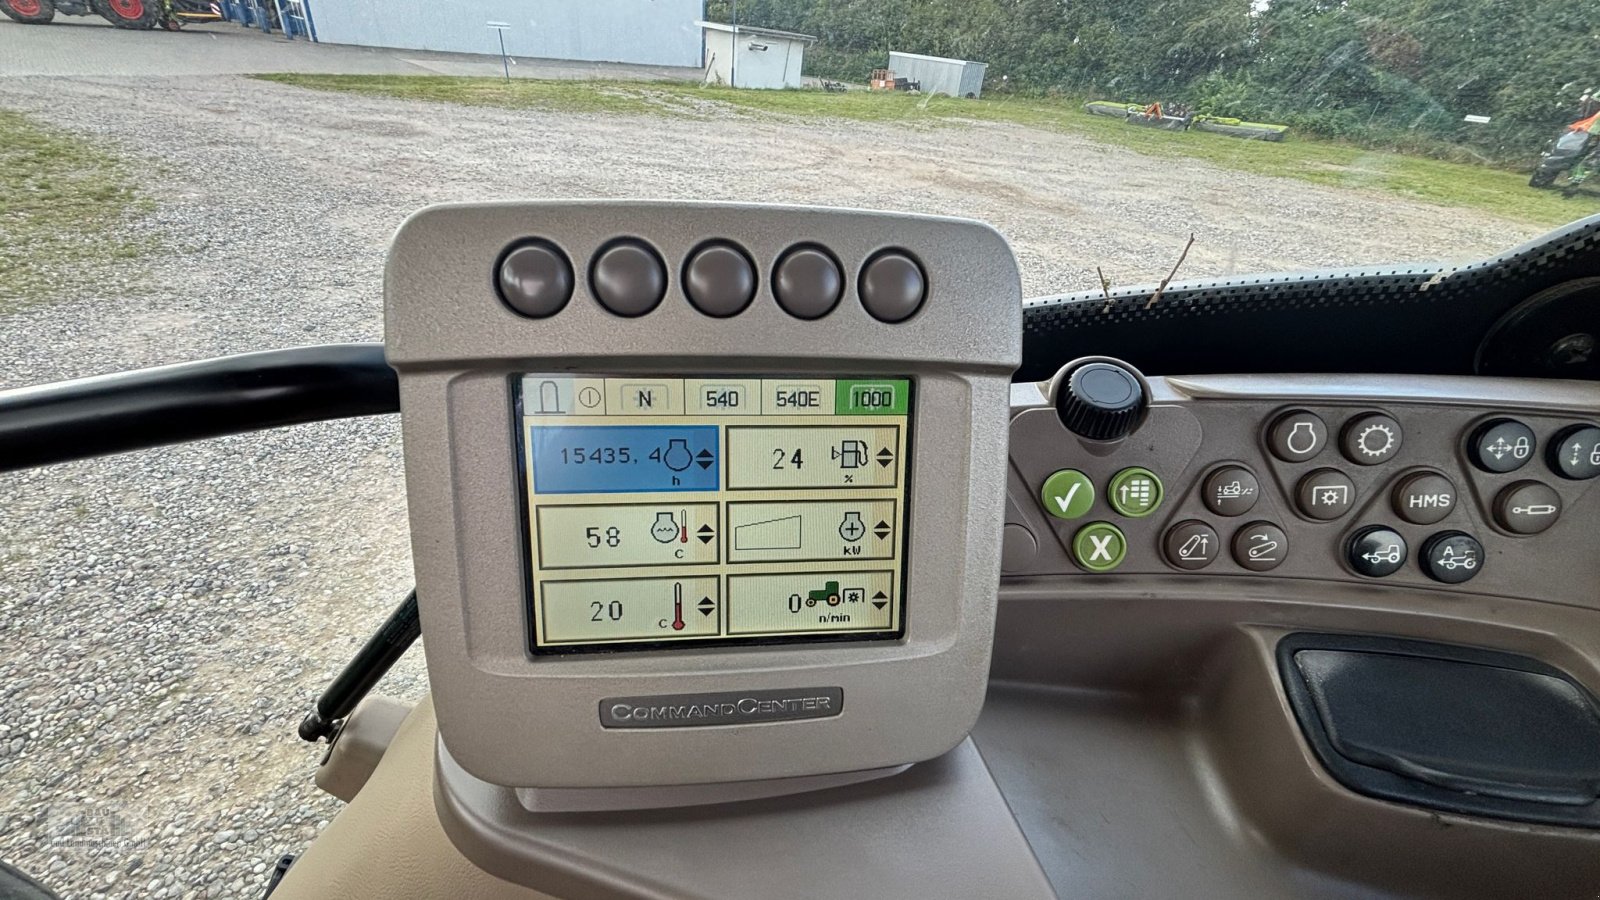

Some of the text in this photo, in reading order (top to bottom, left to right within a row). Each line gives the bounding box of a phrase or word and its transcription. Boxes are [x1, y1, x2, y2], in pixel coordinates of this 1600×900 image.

[638, 390, 652, 407] N
[706, 390, 739, 407] 540
[776, 390, 820, 407] 540E
[853, 390, 892, 407] 1000
[772, 448, 803, 470] 24
[672, 475, 681, 486] h
[1409, 493, 1451, 508] HMS
[586, 526, 621, 548] 58
[843, 545, 862, 556] kW
[1442, 545, 1454, 556] A
[590, 600, 623, 622] 20
[818, 612, 851, 624] n/min
